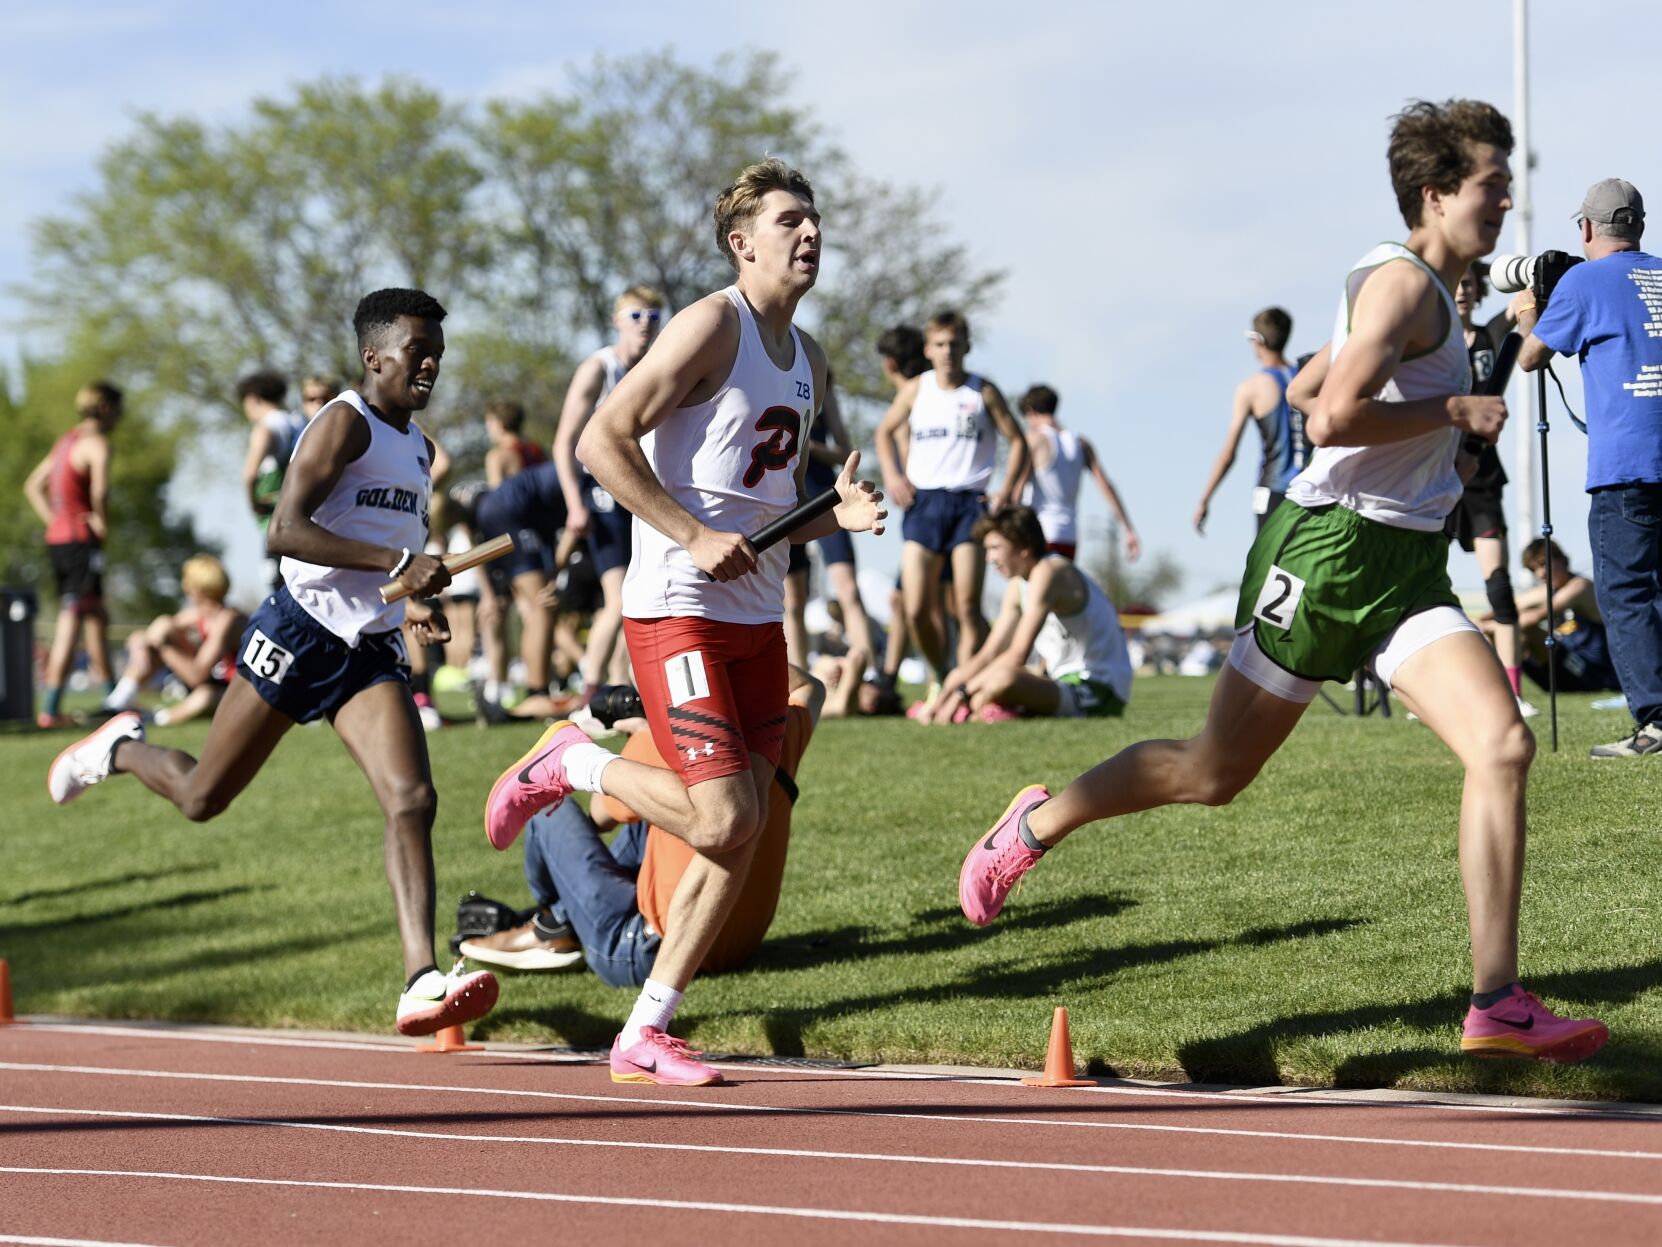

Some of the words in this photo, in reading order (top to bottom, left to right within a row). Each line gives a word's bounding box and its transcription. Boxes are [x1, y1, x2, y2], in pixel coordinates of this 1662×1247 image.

[796, 381, 810, 400] Z8
[356, 488, 417, 516] GOLDEN
[1261, 574, 1292, 624] 2
[251, 639, 286, 677] 15
[682, 656, 696, 696] 1
